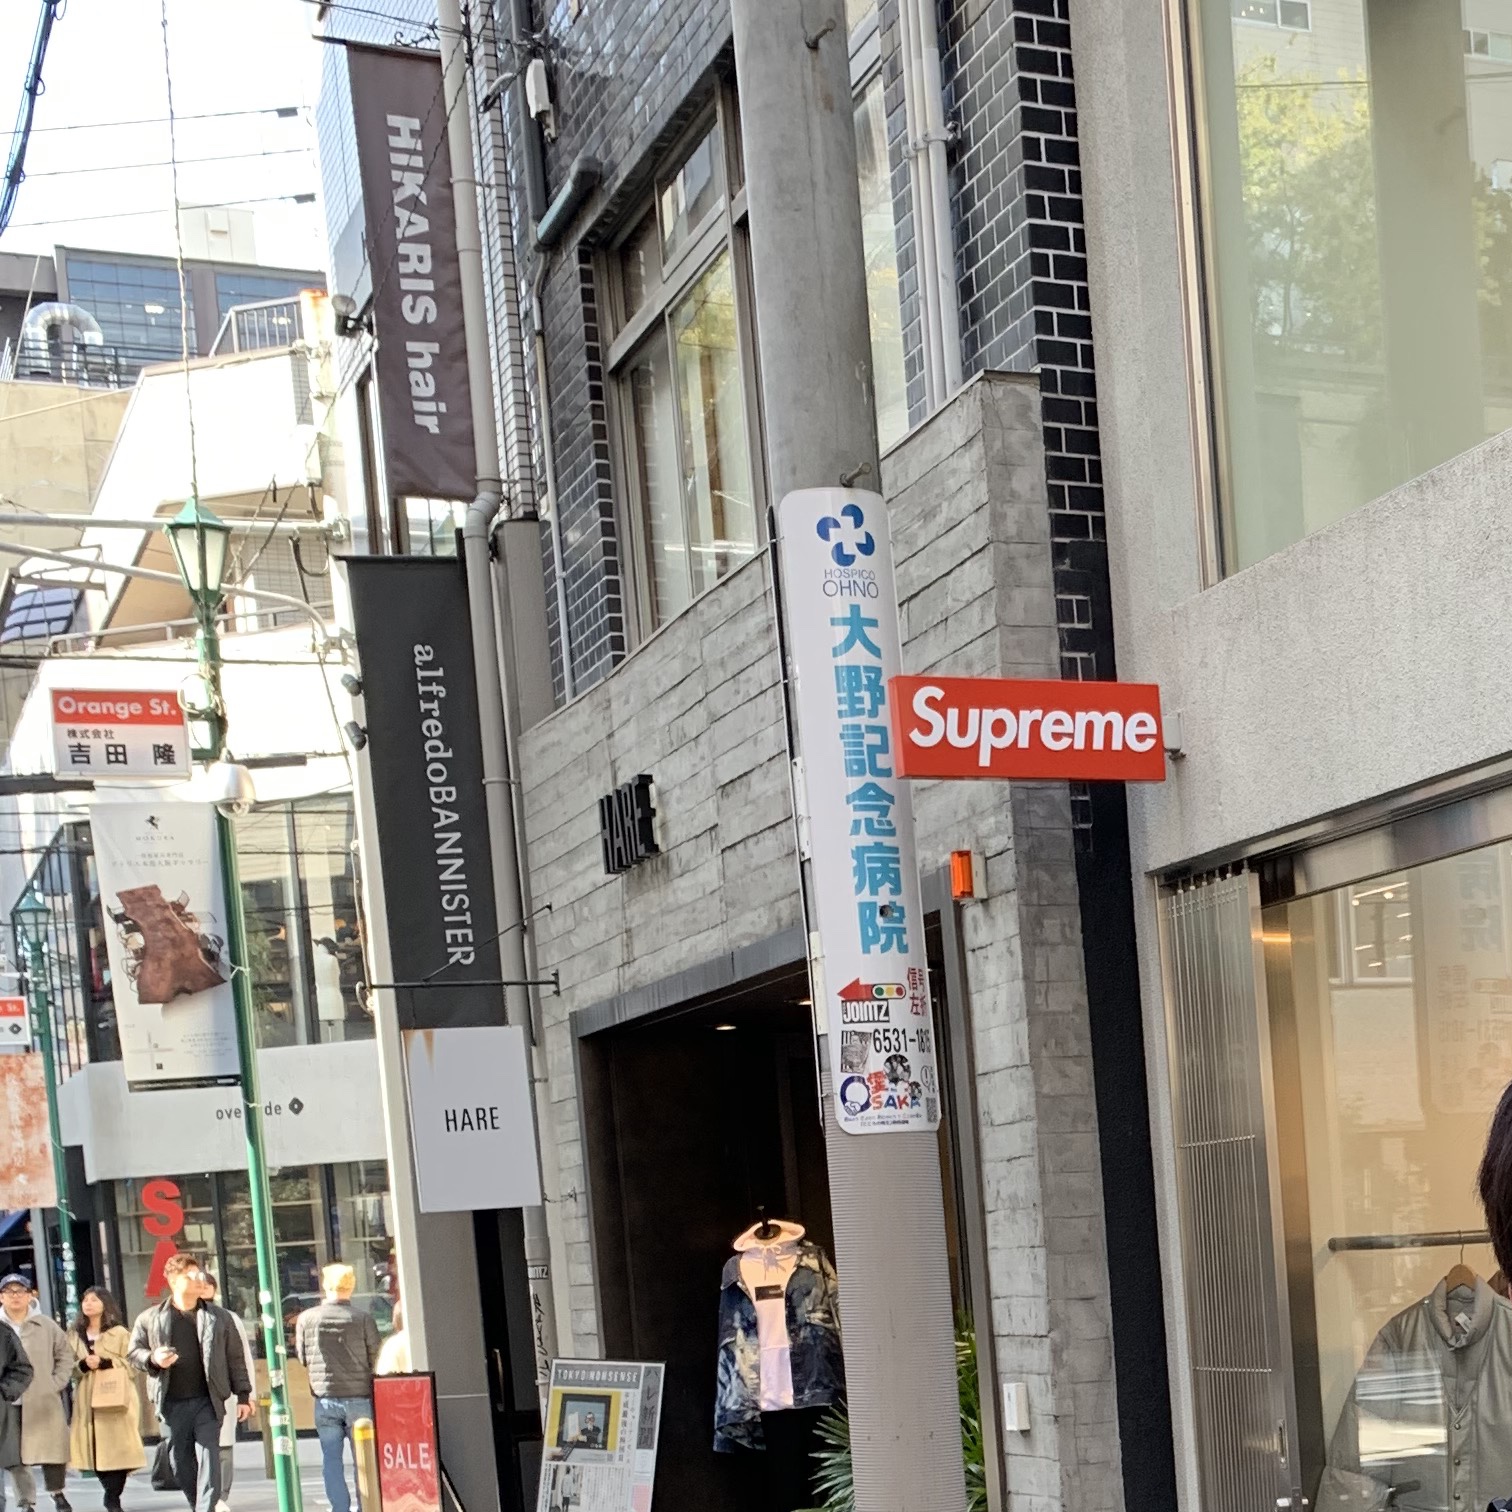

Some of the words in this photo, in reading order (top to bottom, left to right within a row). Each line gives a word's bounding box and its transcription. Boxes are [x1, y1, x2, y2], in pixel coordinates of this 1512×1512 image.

[385, 113, 438, 325] HIKARIS
[405, 341, 447, 435] hair
[822, 580, 880, 598] OHNO
[823, 568, 877, 581] HOSPICO
[58, 696, 143, 719] Orange
[150, 699, 177, 716] St.
[909, 686, 1158, 767] Supreme
[413, 643, 475, 967] alfredoBANNISTER
[830, 604, 910, 955] 大野記念病院
[445, 1106, 501, 1133] HARE
[383, 1442, 432, 1471] SALE
